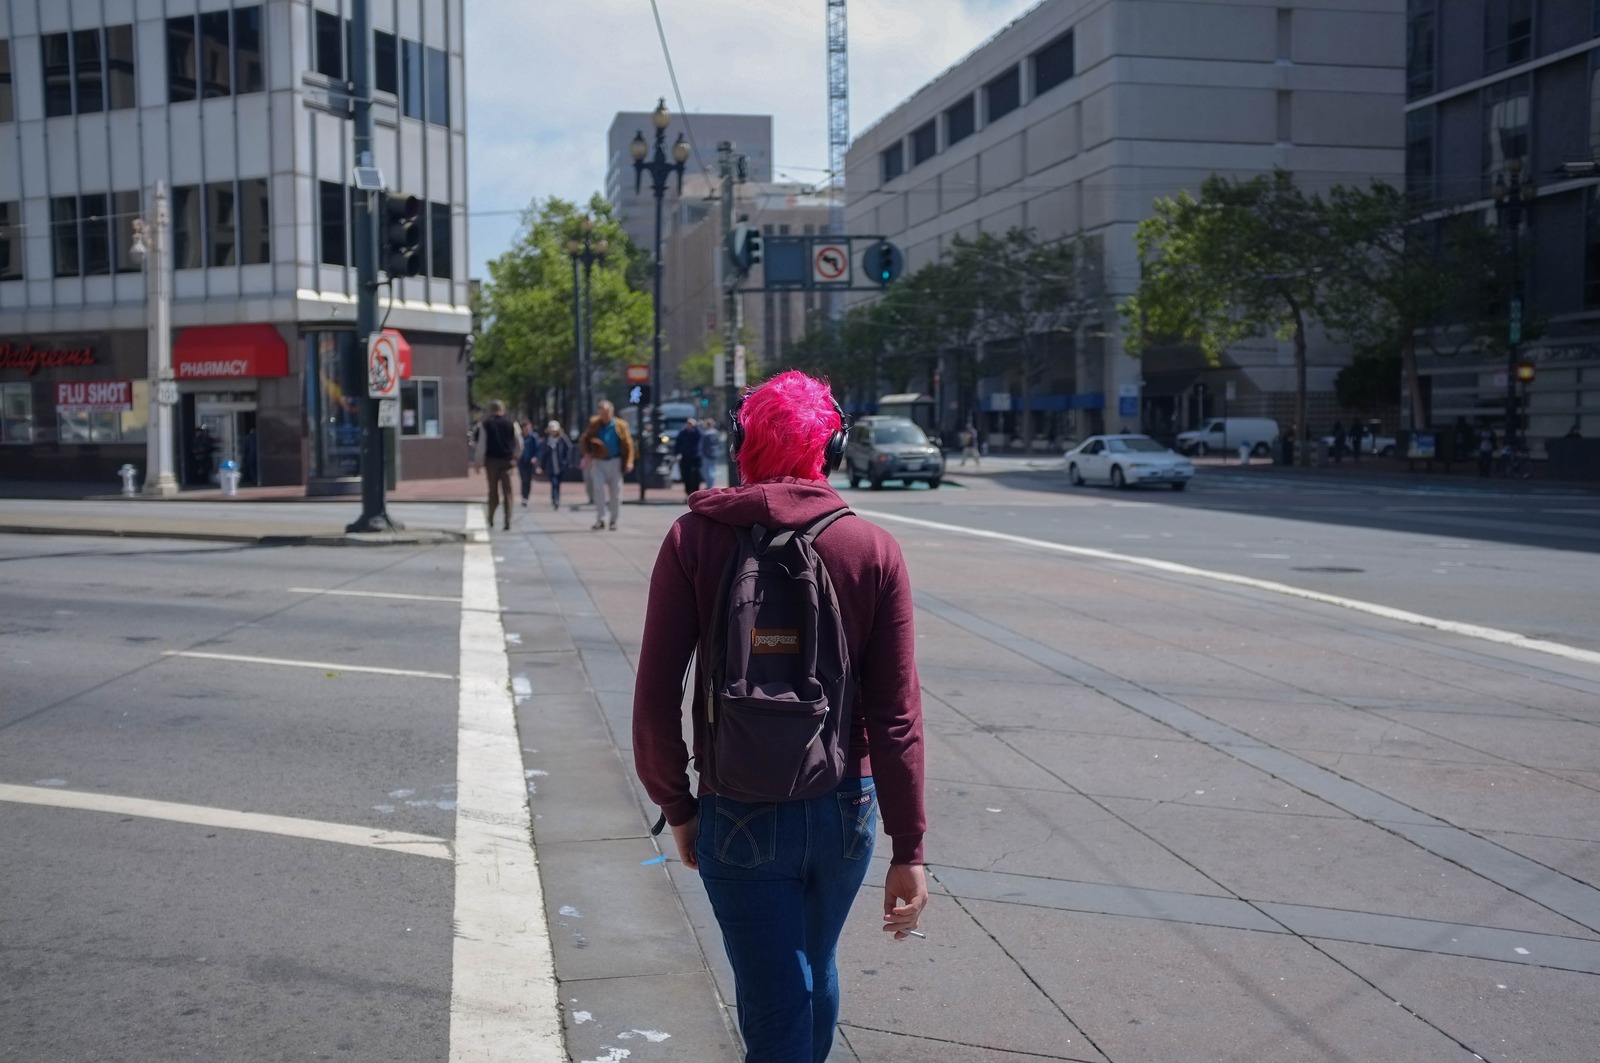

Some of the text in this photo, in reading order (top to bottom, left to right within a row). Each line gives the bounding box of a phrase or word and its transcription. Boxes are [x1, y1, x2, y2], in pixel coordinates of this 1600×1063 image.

[180, 360, 248, 377] PHARMACY
[58, 382, 127, 403] FLU SHOT
